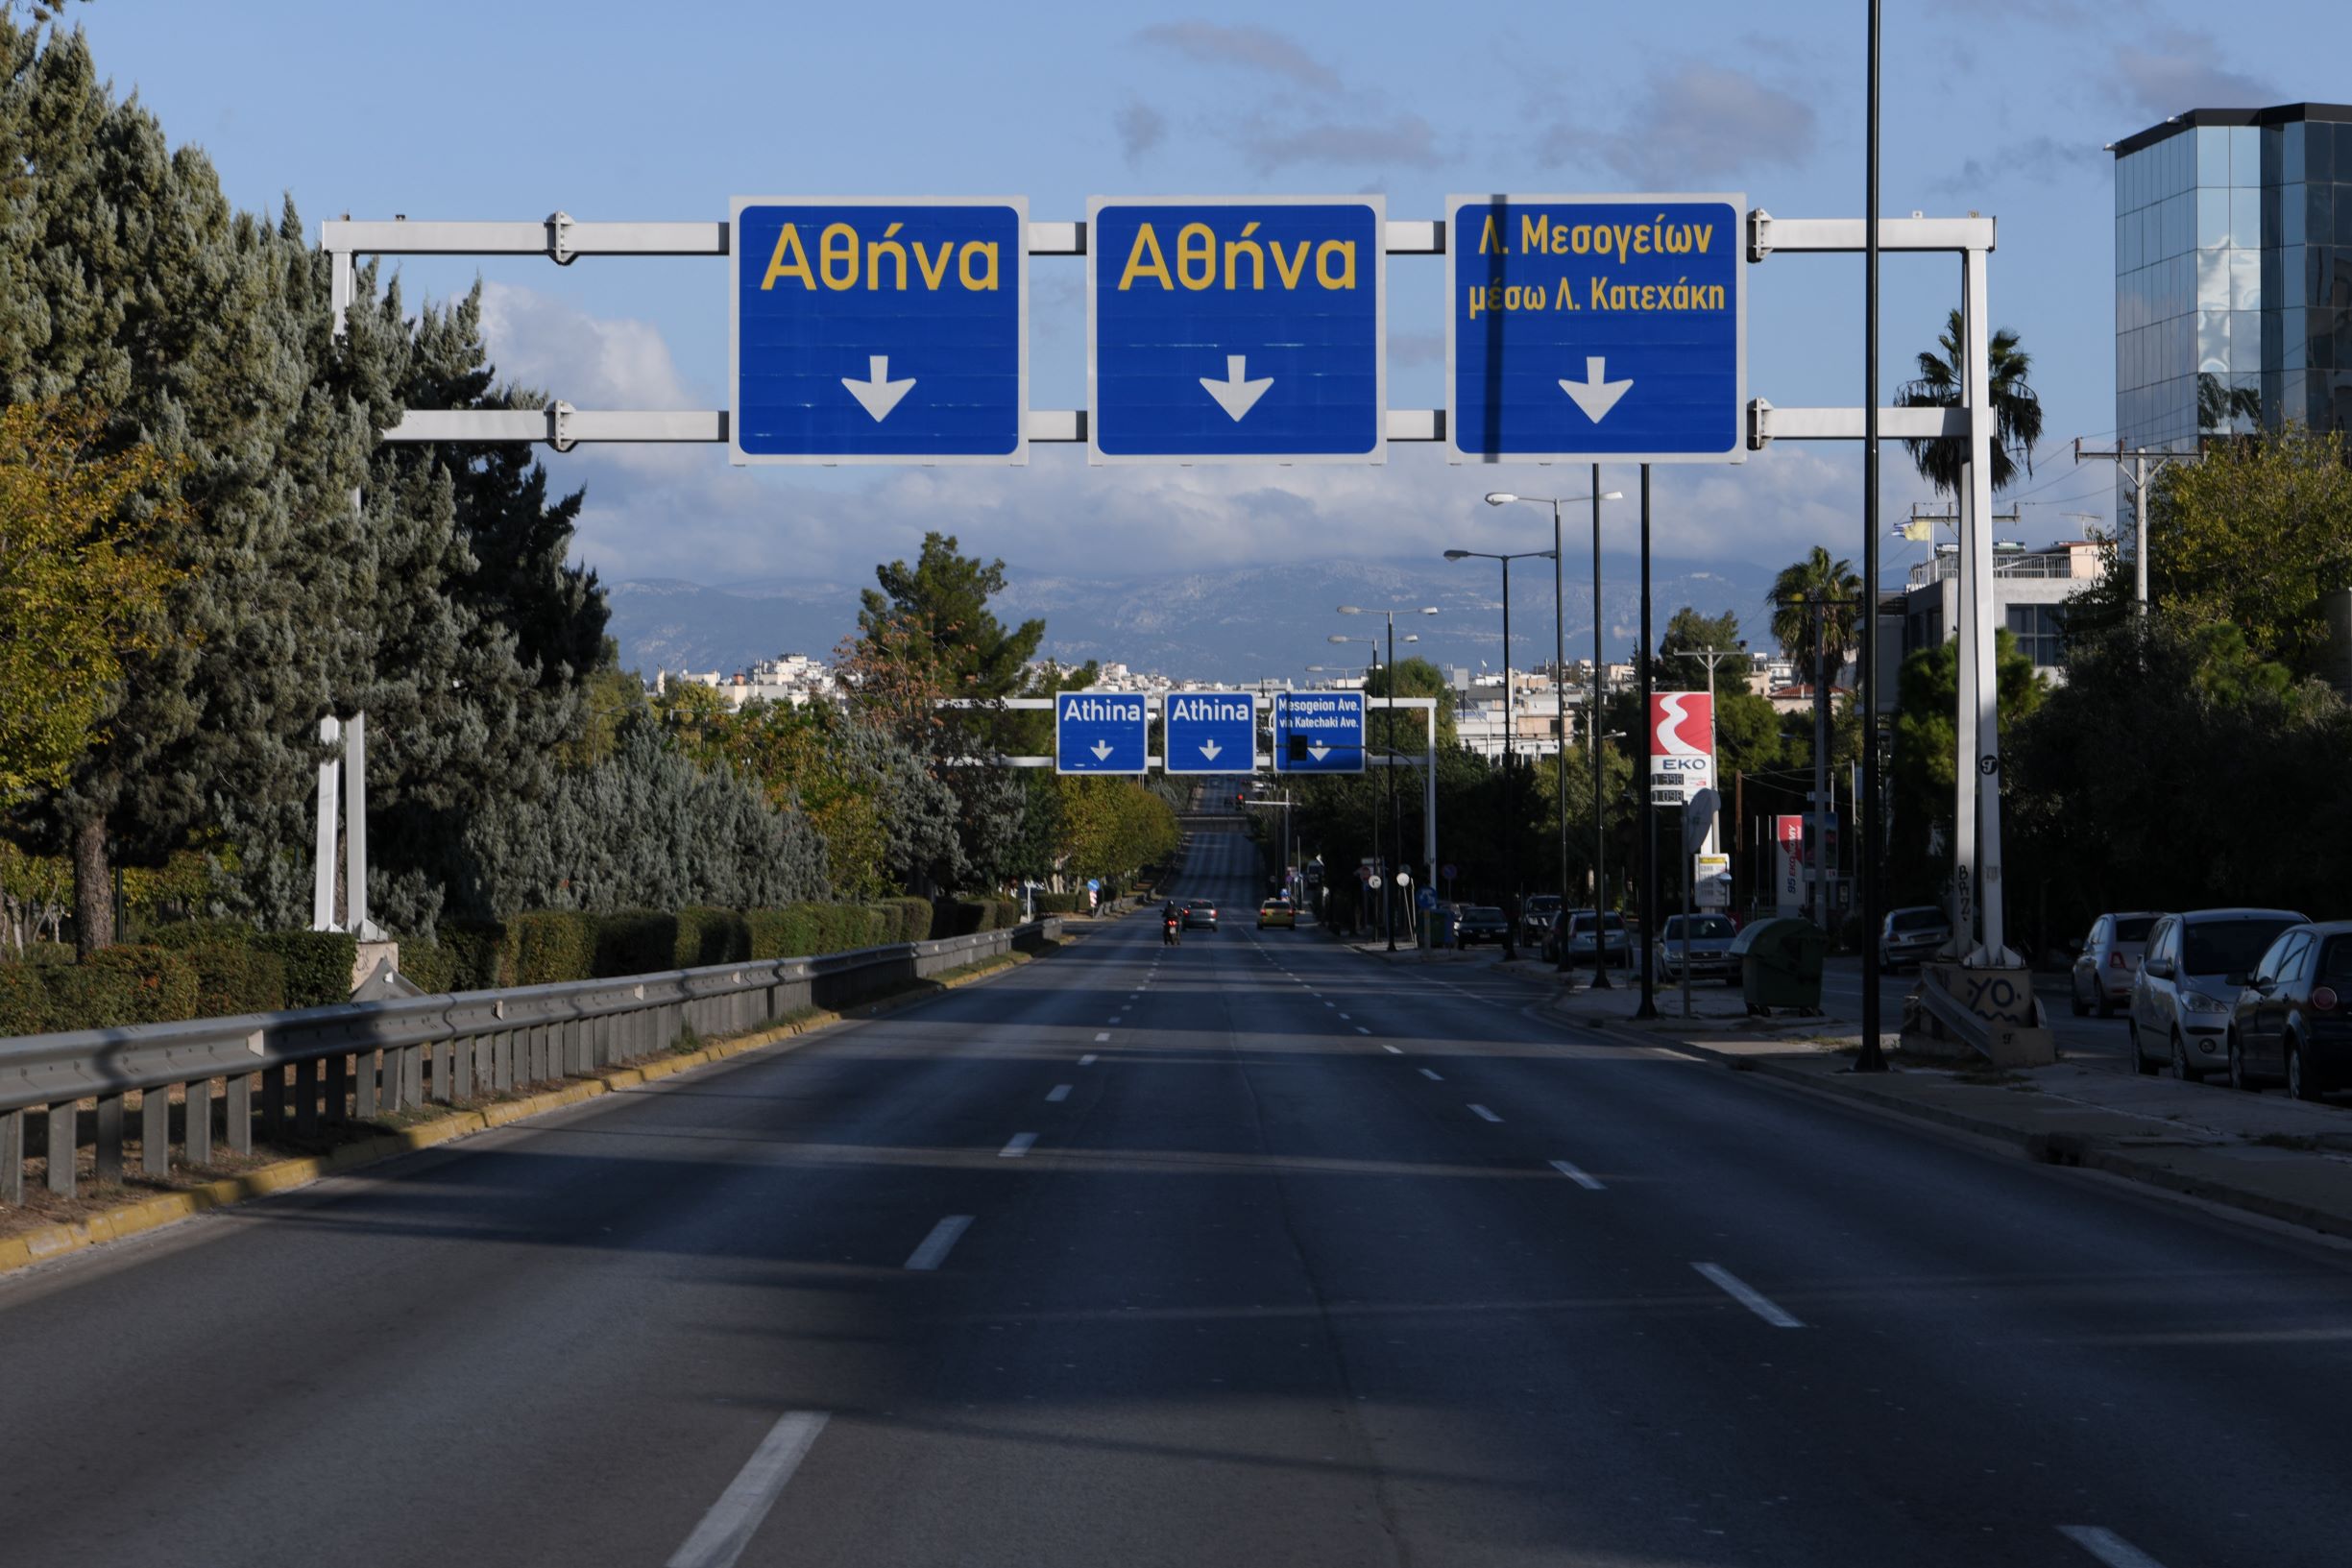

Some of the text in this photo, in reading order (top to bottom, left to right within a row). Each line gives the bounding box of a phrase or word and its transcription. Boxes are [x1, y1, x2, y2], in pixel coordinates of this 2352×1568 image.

[1478, 213, 1713, 264] Λ. Μεσογείων
[760, 222, 999, 291] Αθήνα
[1117, 222, 1356, 290] Αθήνα
[1468, 276, 1725, 320] μέσω Λ. Κατεχάκη
[1063, 699, 1141, 721] Athina
[1172, 699, 1249, 721] Athina
[1278, 697, 1360, 714] Mesogeion Ave.
[1279, 716, 1359, 728] via Katechaki Ave.
[1662, 759, 1707, 770] EKO
